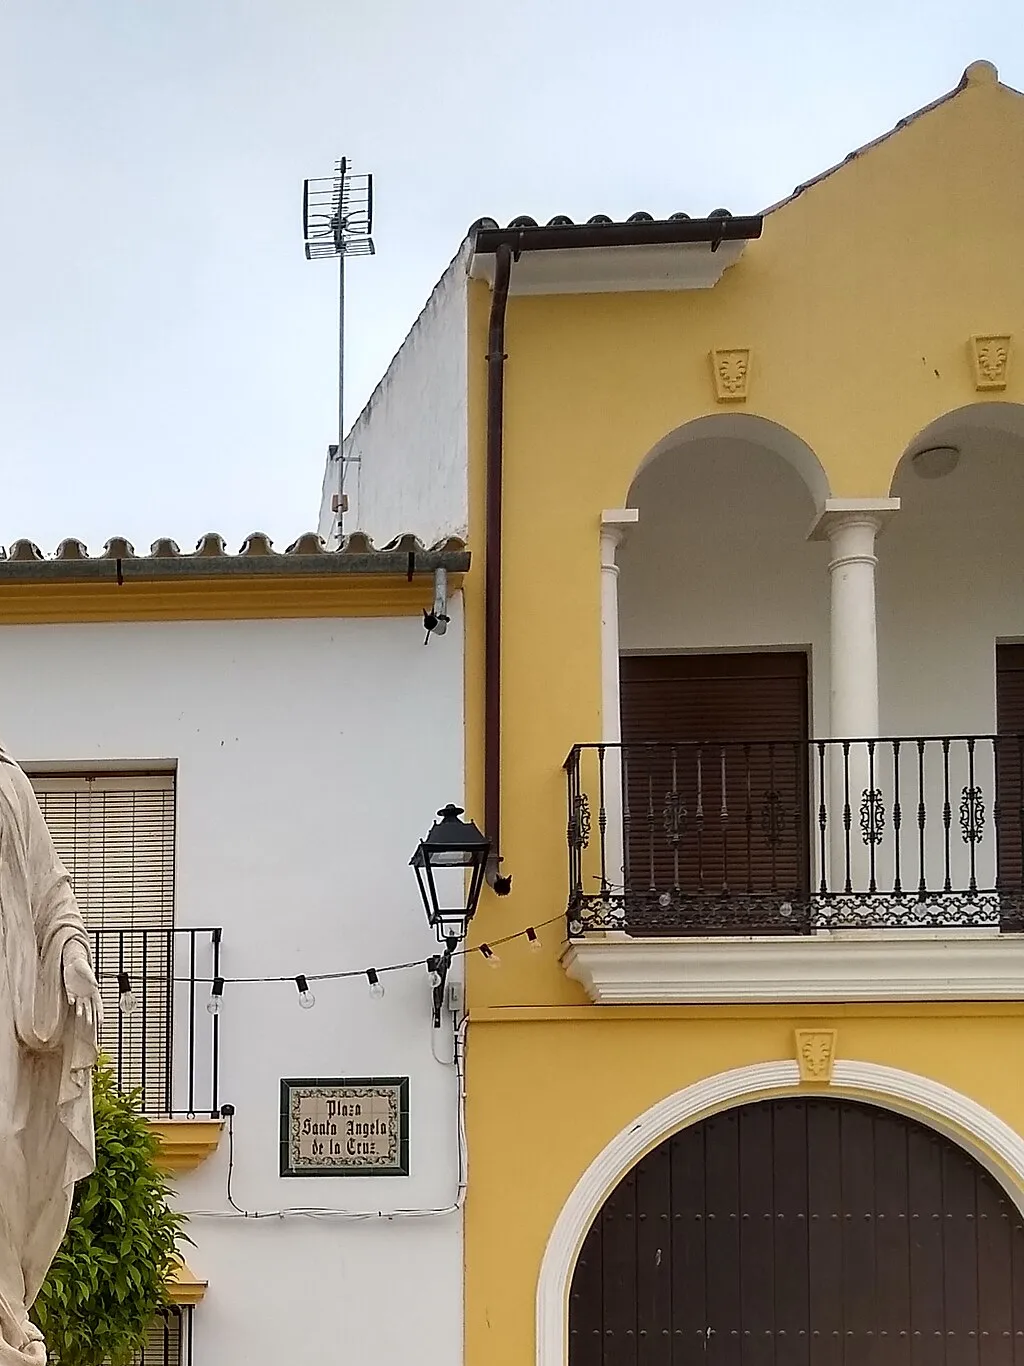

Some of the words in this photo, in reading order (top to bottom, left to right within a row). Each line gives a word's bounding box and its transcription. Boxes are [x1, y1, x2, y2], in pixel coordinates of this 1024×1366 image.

[326, 1099, 362, 1119] Plaza
[301, 1117, 337, 1136] Santa
[346, 1118, 387, 1138] Angela
[311, 1138, 324, 1155] de
[329, 1138, 341, 1155] la
